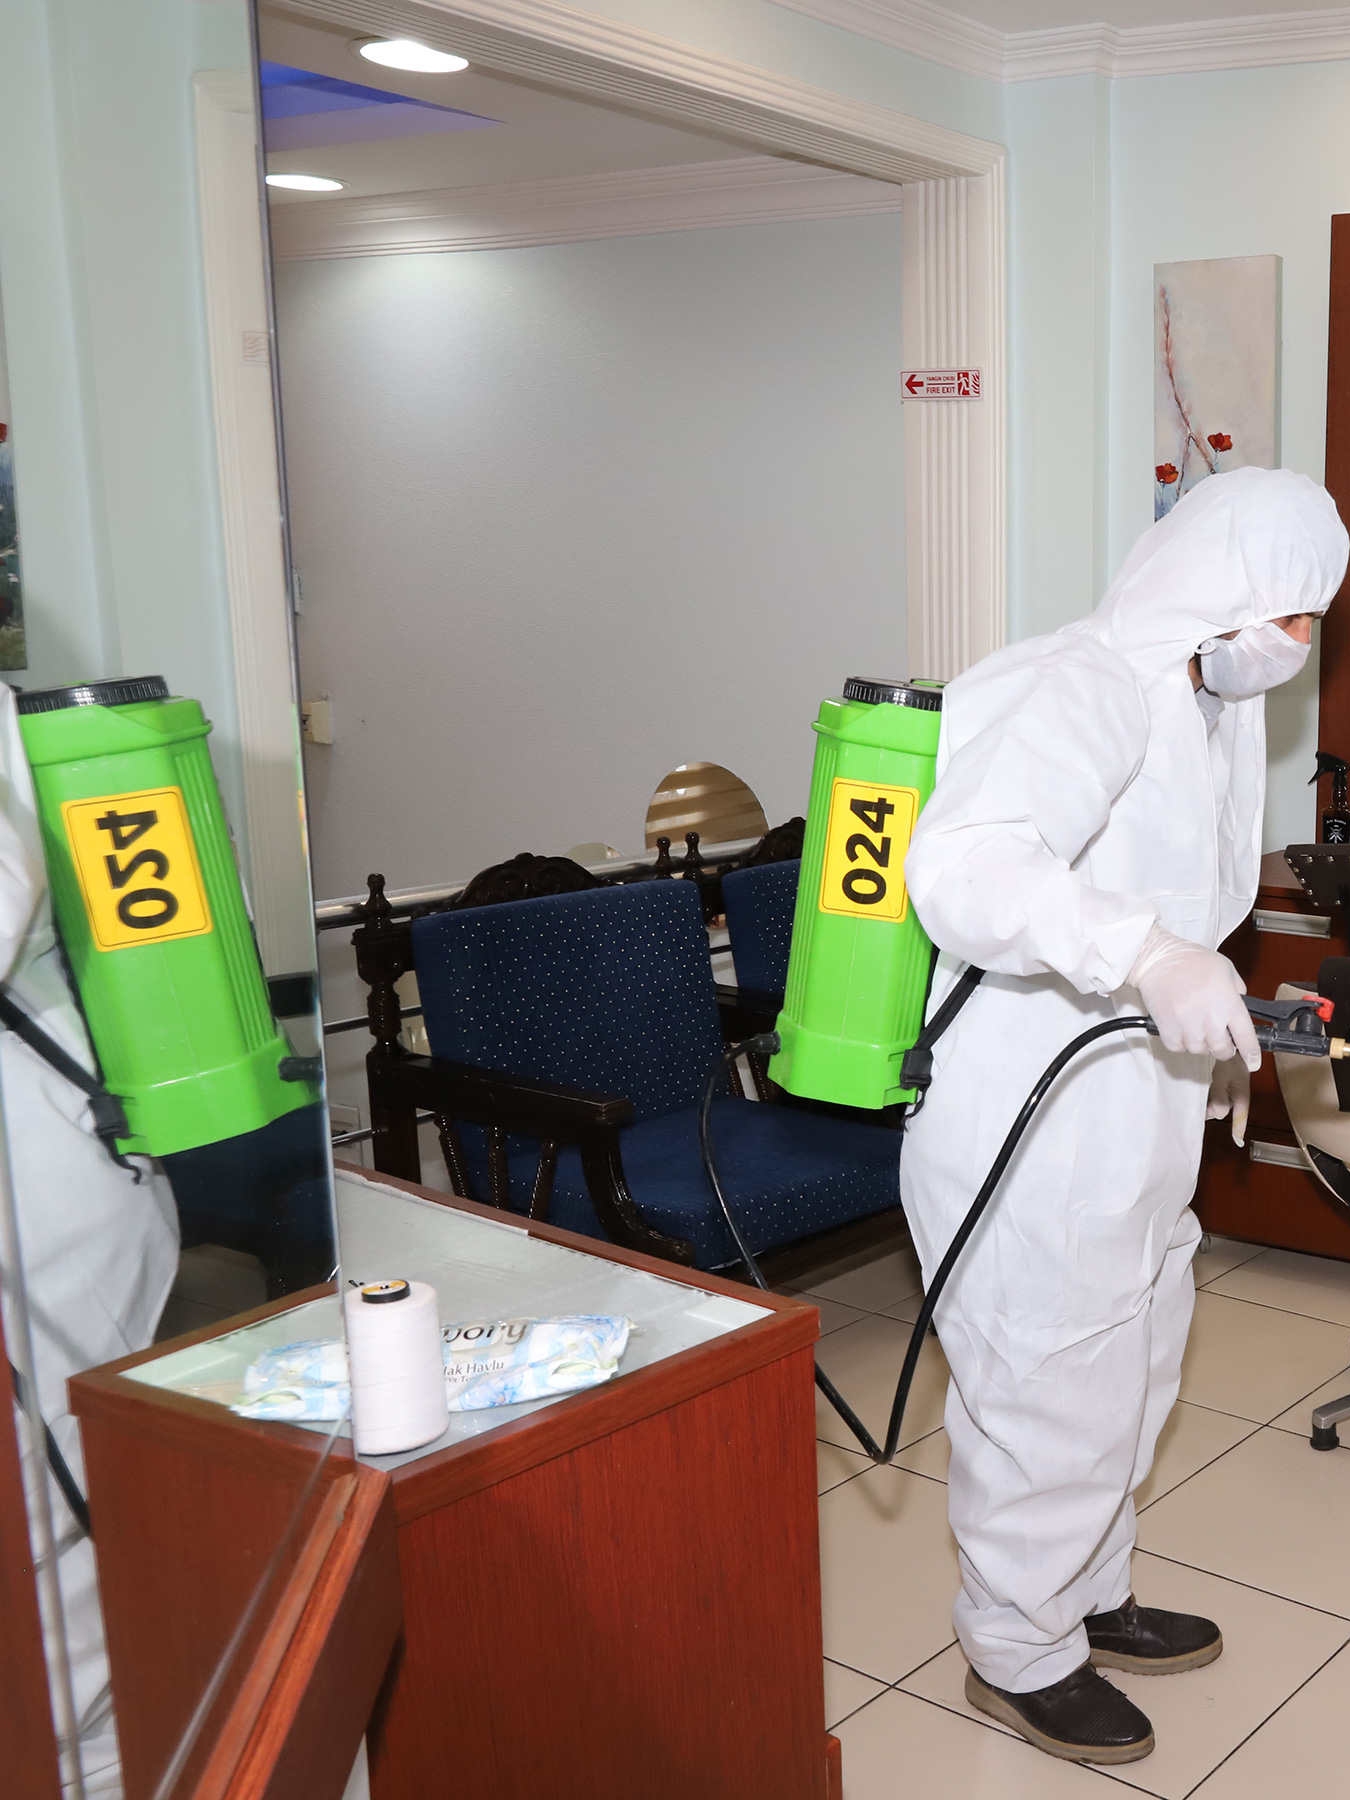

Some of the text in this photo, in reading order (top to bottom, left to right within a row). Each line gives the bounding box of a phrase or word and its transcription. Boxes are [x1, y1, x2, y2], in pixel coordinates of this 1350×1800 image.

[841, 796, 895, 905] 024
[443, 1324, 527, 1345] vory
[466, 1360, 504, 1374] Havlu
